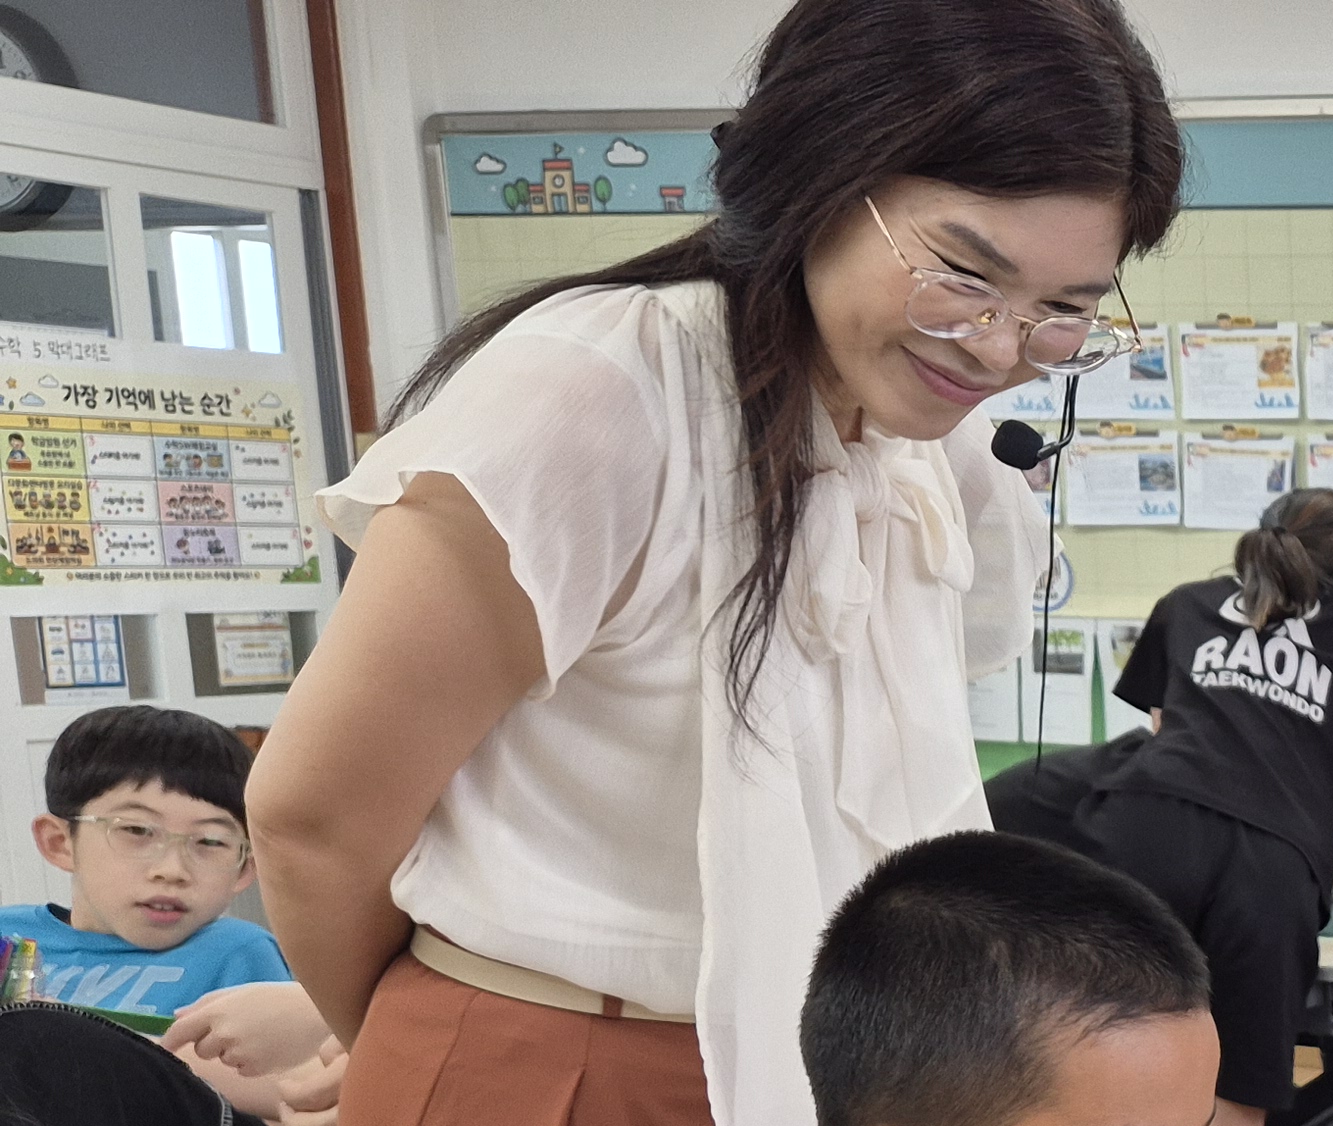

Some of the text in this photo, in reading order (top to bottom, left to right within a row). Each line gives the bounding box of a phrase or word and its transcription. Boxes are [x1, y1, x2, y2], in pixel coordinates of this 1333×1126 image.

[62, 384, 233, 417] 가장 기억에 남는 순간
[1190, 626, 1333, 706] RAON
[1189, 670, 1325, 723] TAEKWONDO
